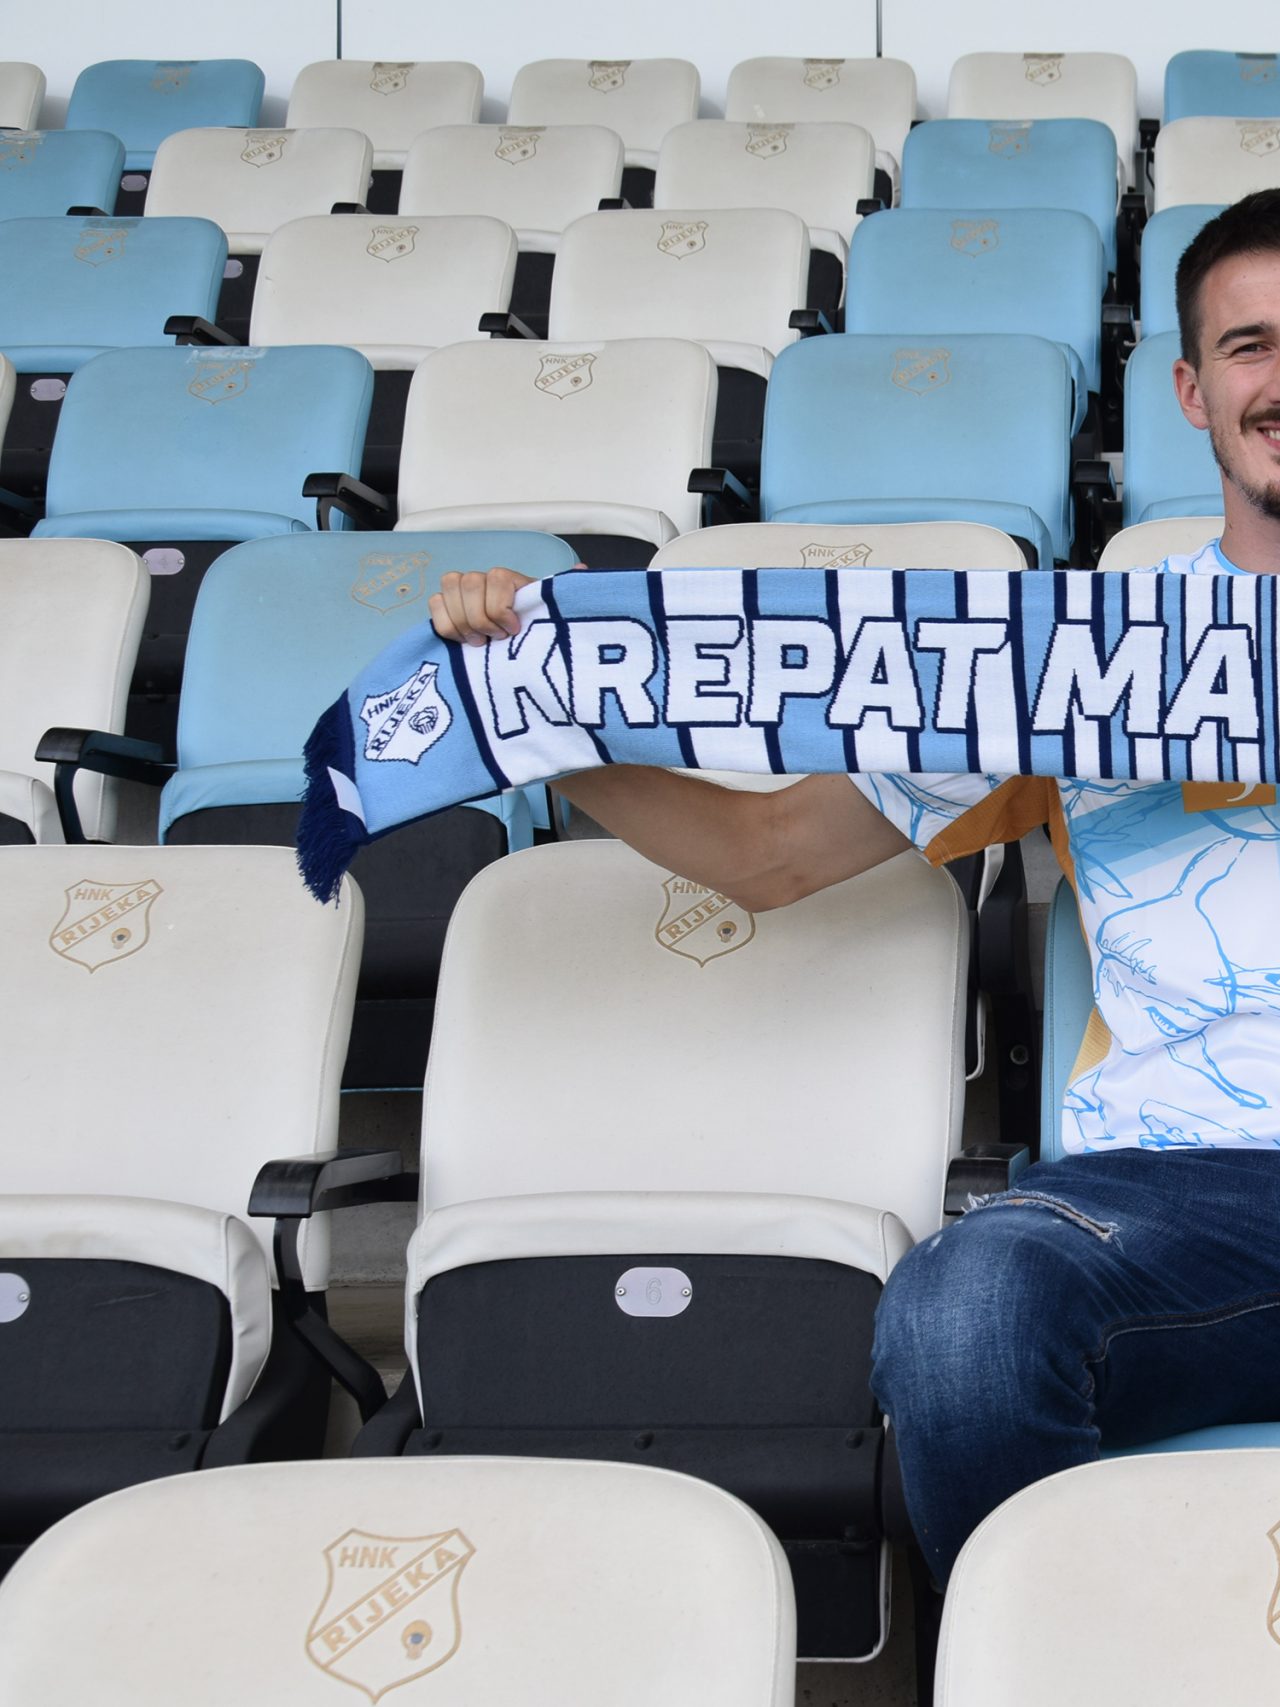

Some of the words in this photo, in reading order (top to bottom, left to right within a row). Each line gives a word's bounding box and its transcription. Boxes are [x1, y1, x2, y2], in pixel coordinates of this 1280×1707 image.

[541, 356, 590, 387] RIJEKA
[545, 356, 567, 364] HNK
[808, 549, 835, 557] HNK
[485, 615, 1012, 740] KREPAT
[1029, 619, 1264, 744] MA
[367, 690, 400, 719] HNK
[371, 671, 433, 752] RIJEKA
[74, 888, 113, 901] HNK
[60, 889, 152, 946] RIJEKA
[665, 894, 728, 940] RIJE
[645, 1277, 663, 1306] 6
[338, 1546, 399, 1570] HNK
[321, 1547, 460, 1652] RIJEKA
